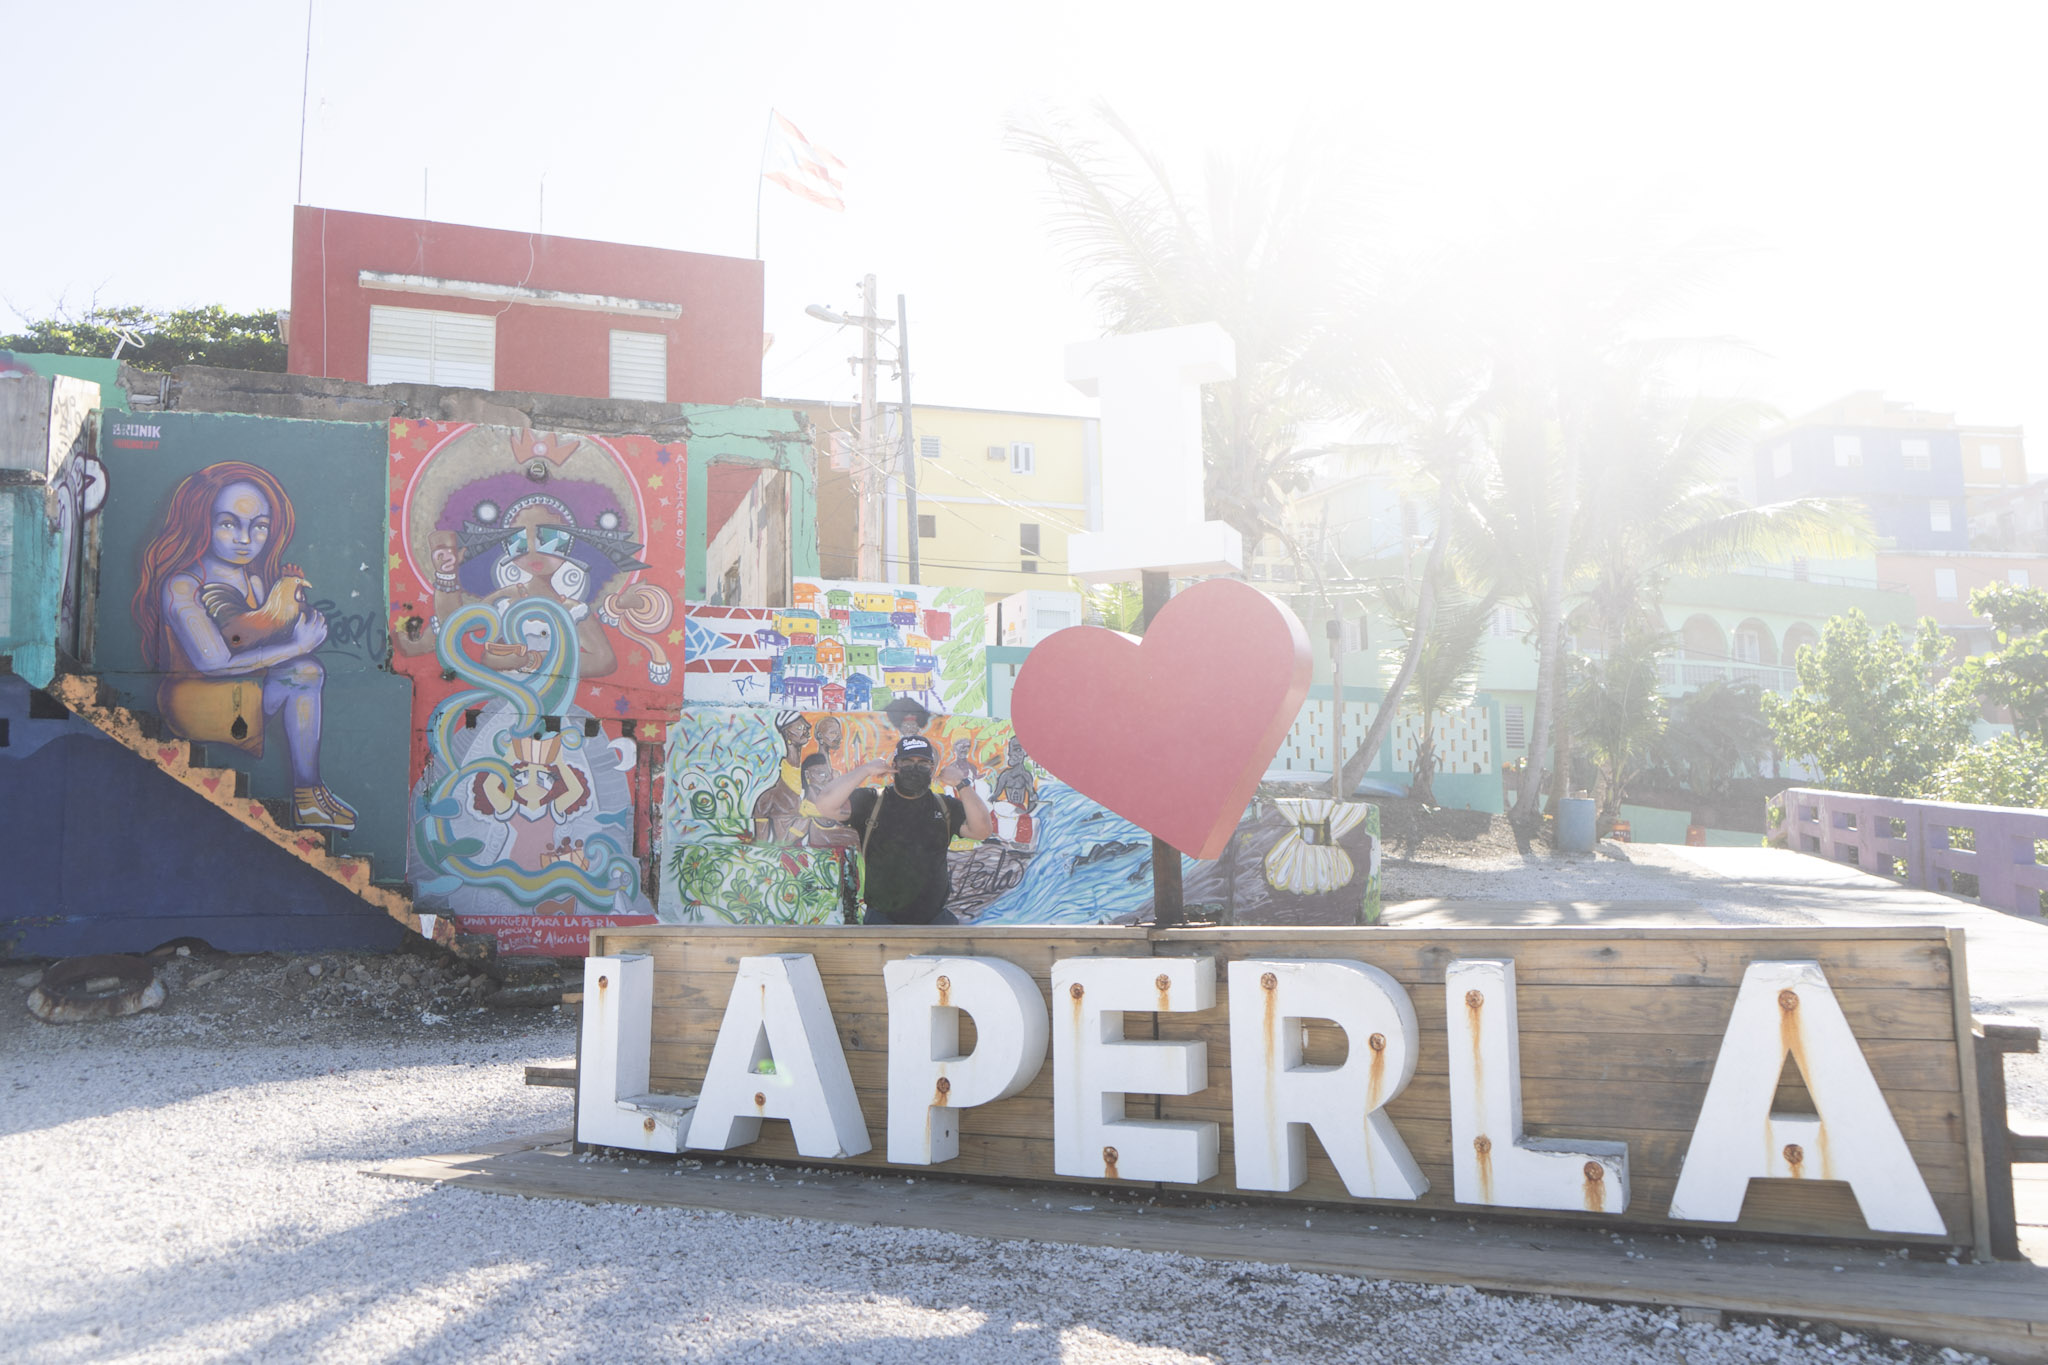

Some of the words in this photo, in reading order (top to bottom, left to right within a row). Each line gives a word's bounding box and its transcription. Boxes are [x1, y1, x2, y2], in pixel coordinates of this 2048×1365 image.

[1064, 321, 1243, 582] I
[488, 916, 529, 926] VIRGEN
[531, 916, 560, 927] PARA
[564, 917, 579, 927] LA
[577, 953, 872, 1159] LA
[882, 954, 1948, 1236] PERLA
